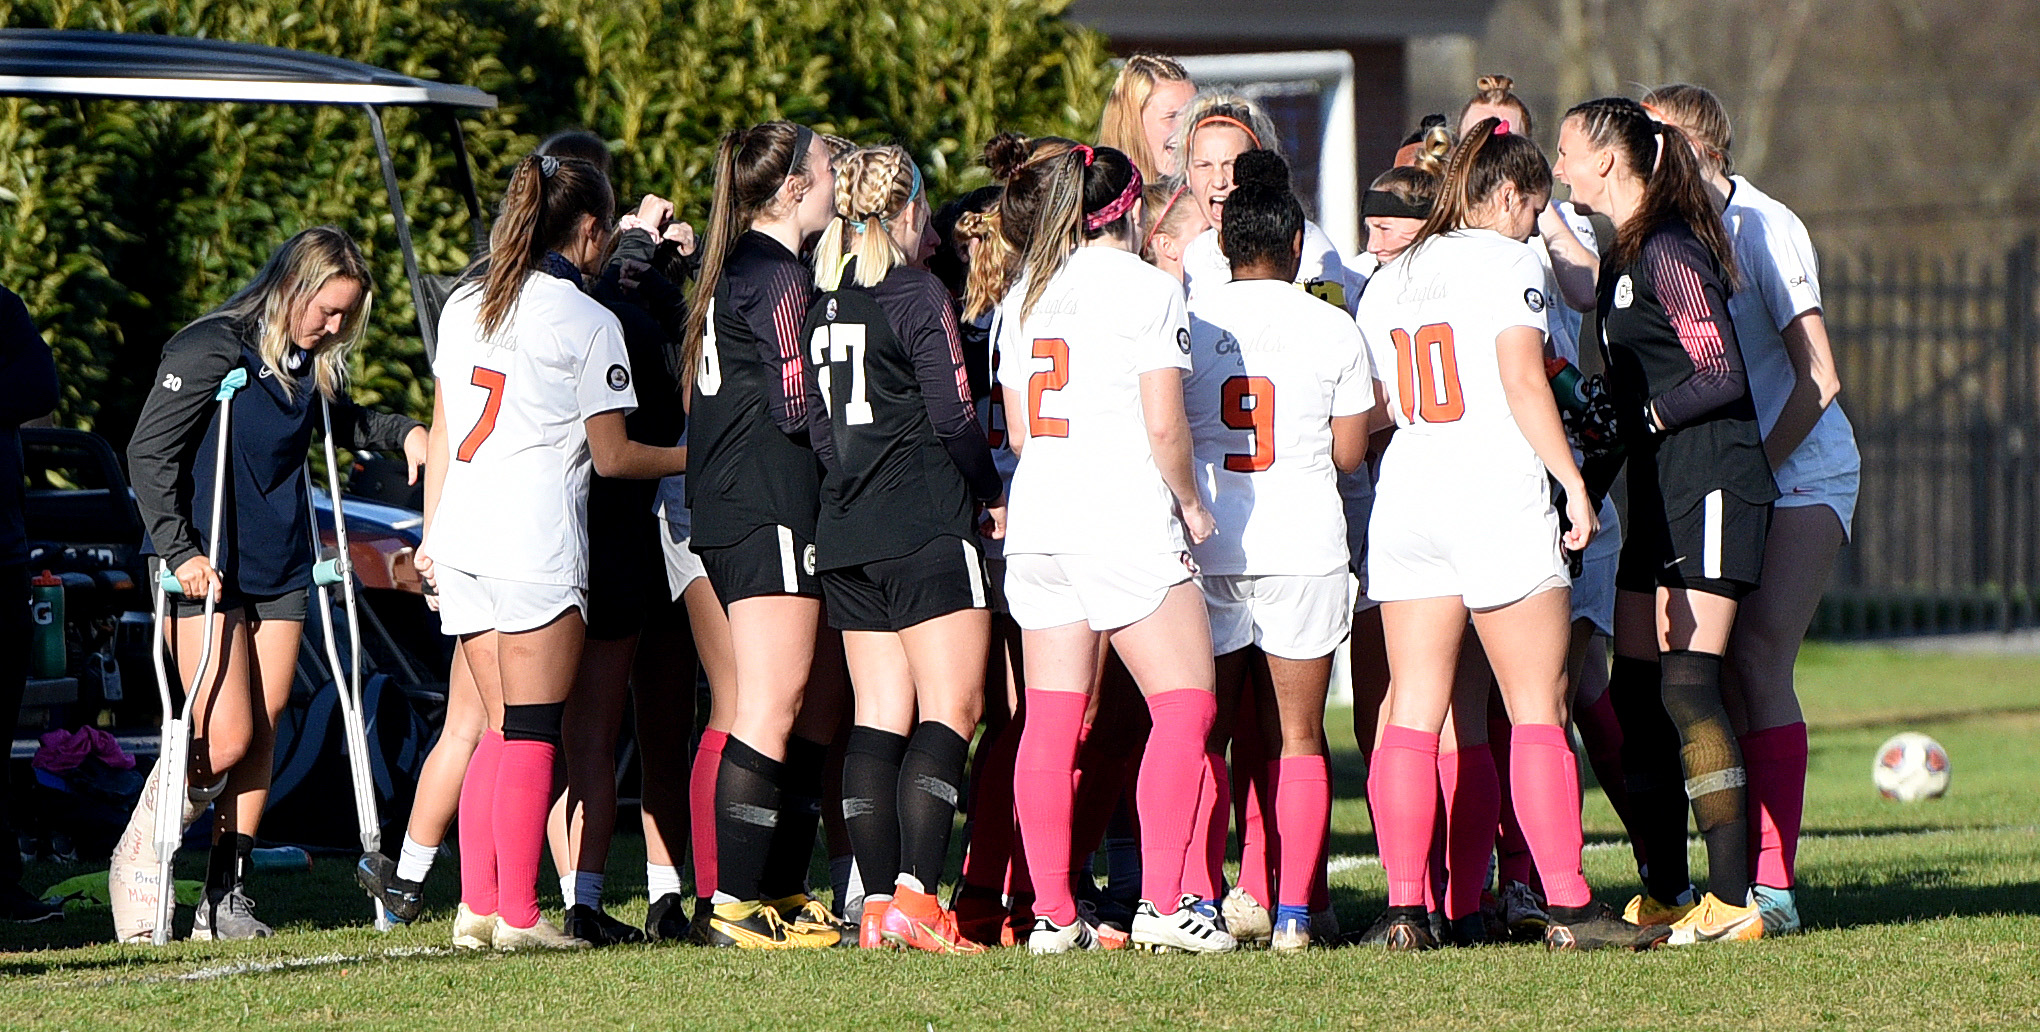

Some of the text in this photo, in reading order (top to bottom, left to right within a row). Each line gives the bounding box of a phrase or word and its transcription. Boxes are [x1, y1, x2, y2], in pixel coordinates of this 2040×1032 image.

[1030, 287, 1080, 328] agles
[162, 373, 182, 392] 20
[456, 365, 507, 463] 7
[1028, 338, 1070, 438] 2
[1390, 322, 1465, 425] 10
[1221, 376, 1275, 473] 9
[33, 602, 53, 625] G
